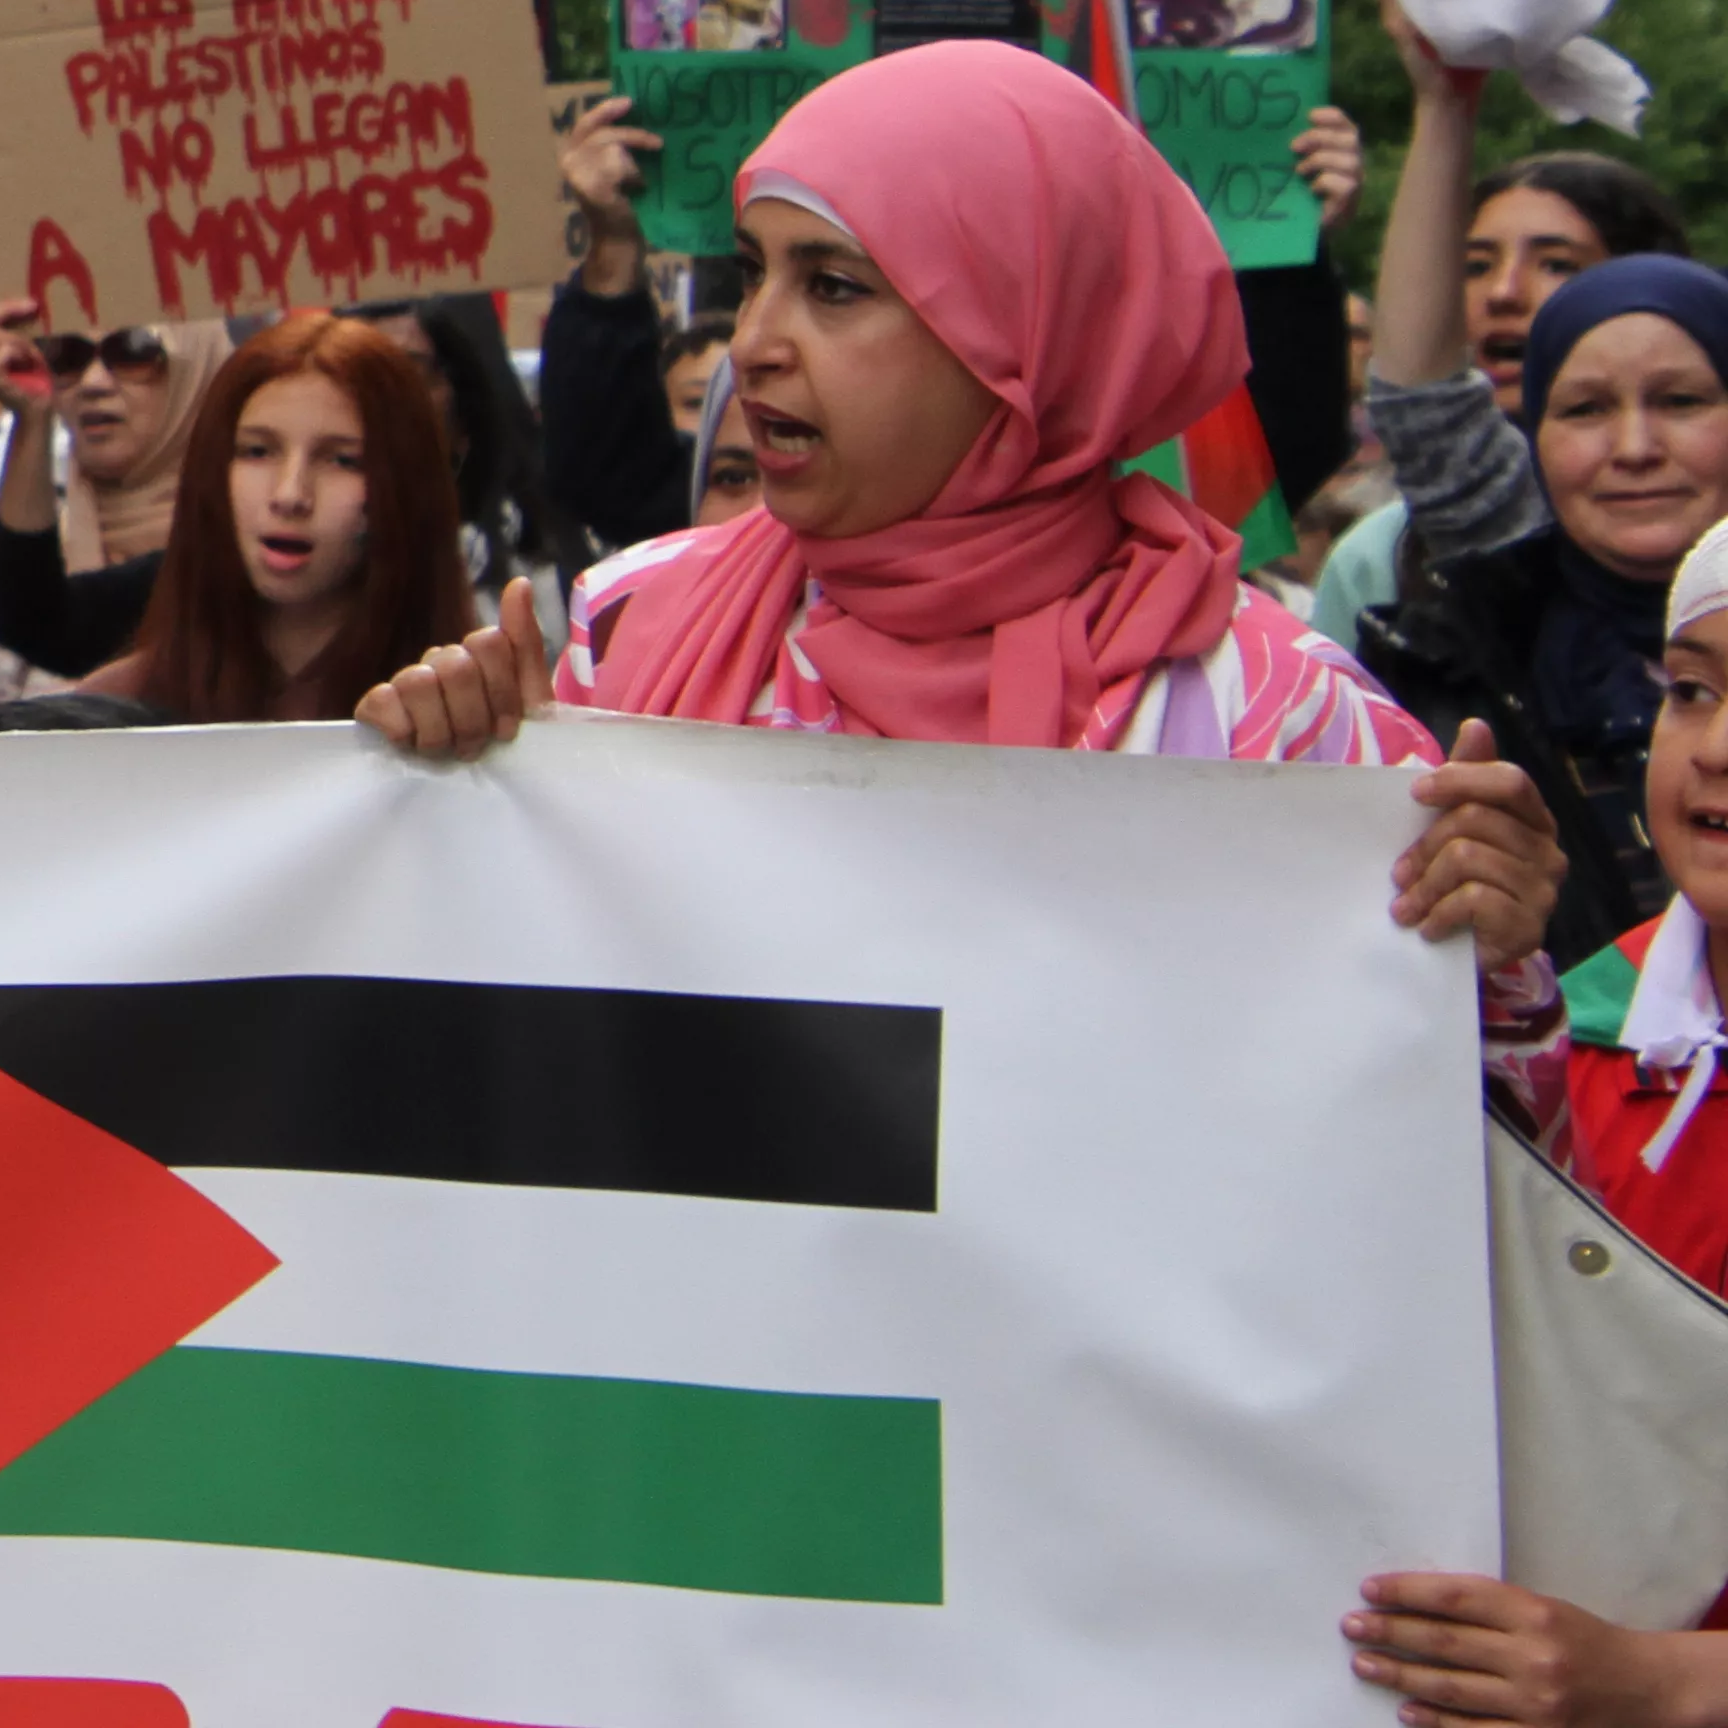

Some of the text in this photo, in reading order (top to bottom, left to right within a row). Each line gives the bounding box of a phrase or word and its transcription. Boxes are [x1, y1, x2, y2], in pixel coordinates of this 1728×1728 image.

[64, 18, 386, 140] PALESTINOS
[119, 117, 214, 204] NO
[243, 74, 478, 174] LLEGAN
[28, 152, 493, 334] A MAYORES
